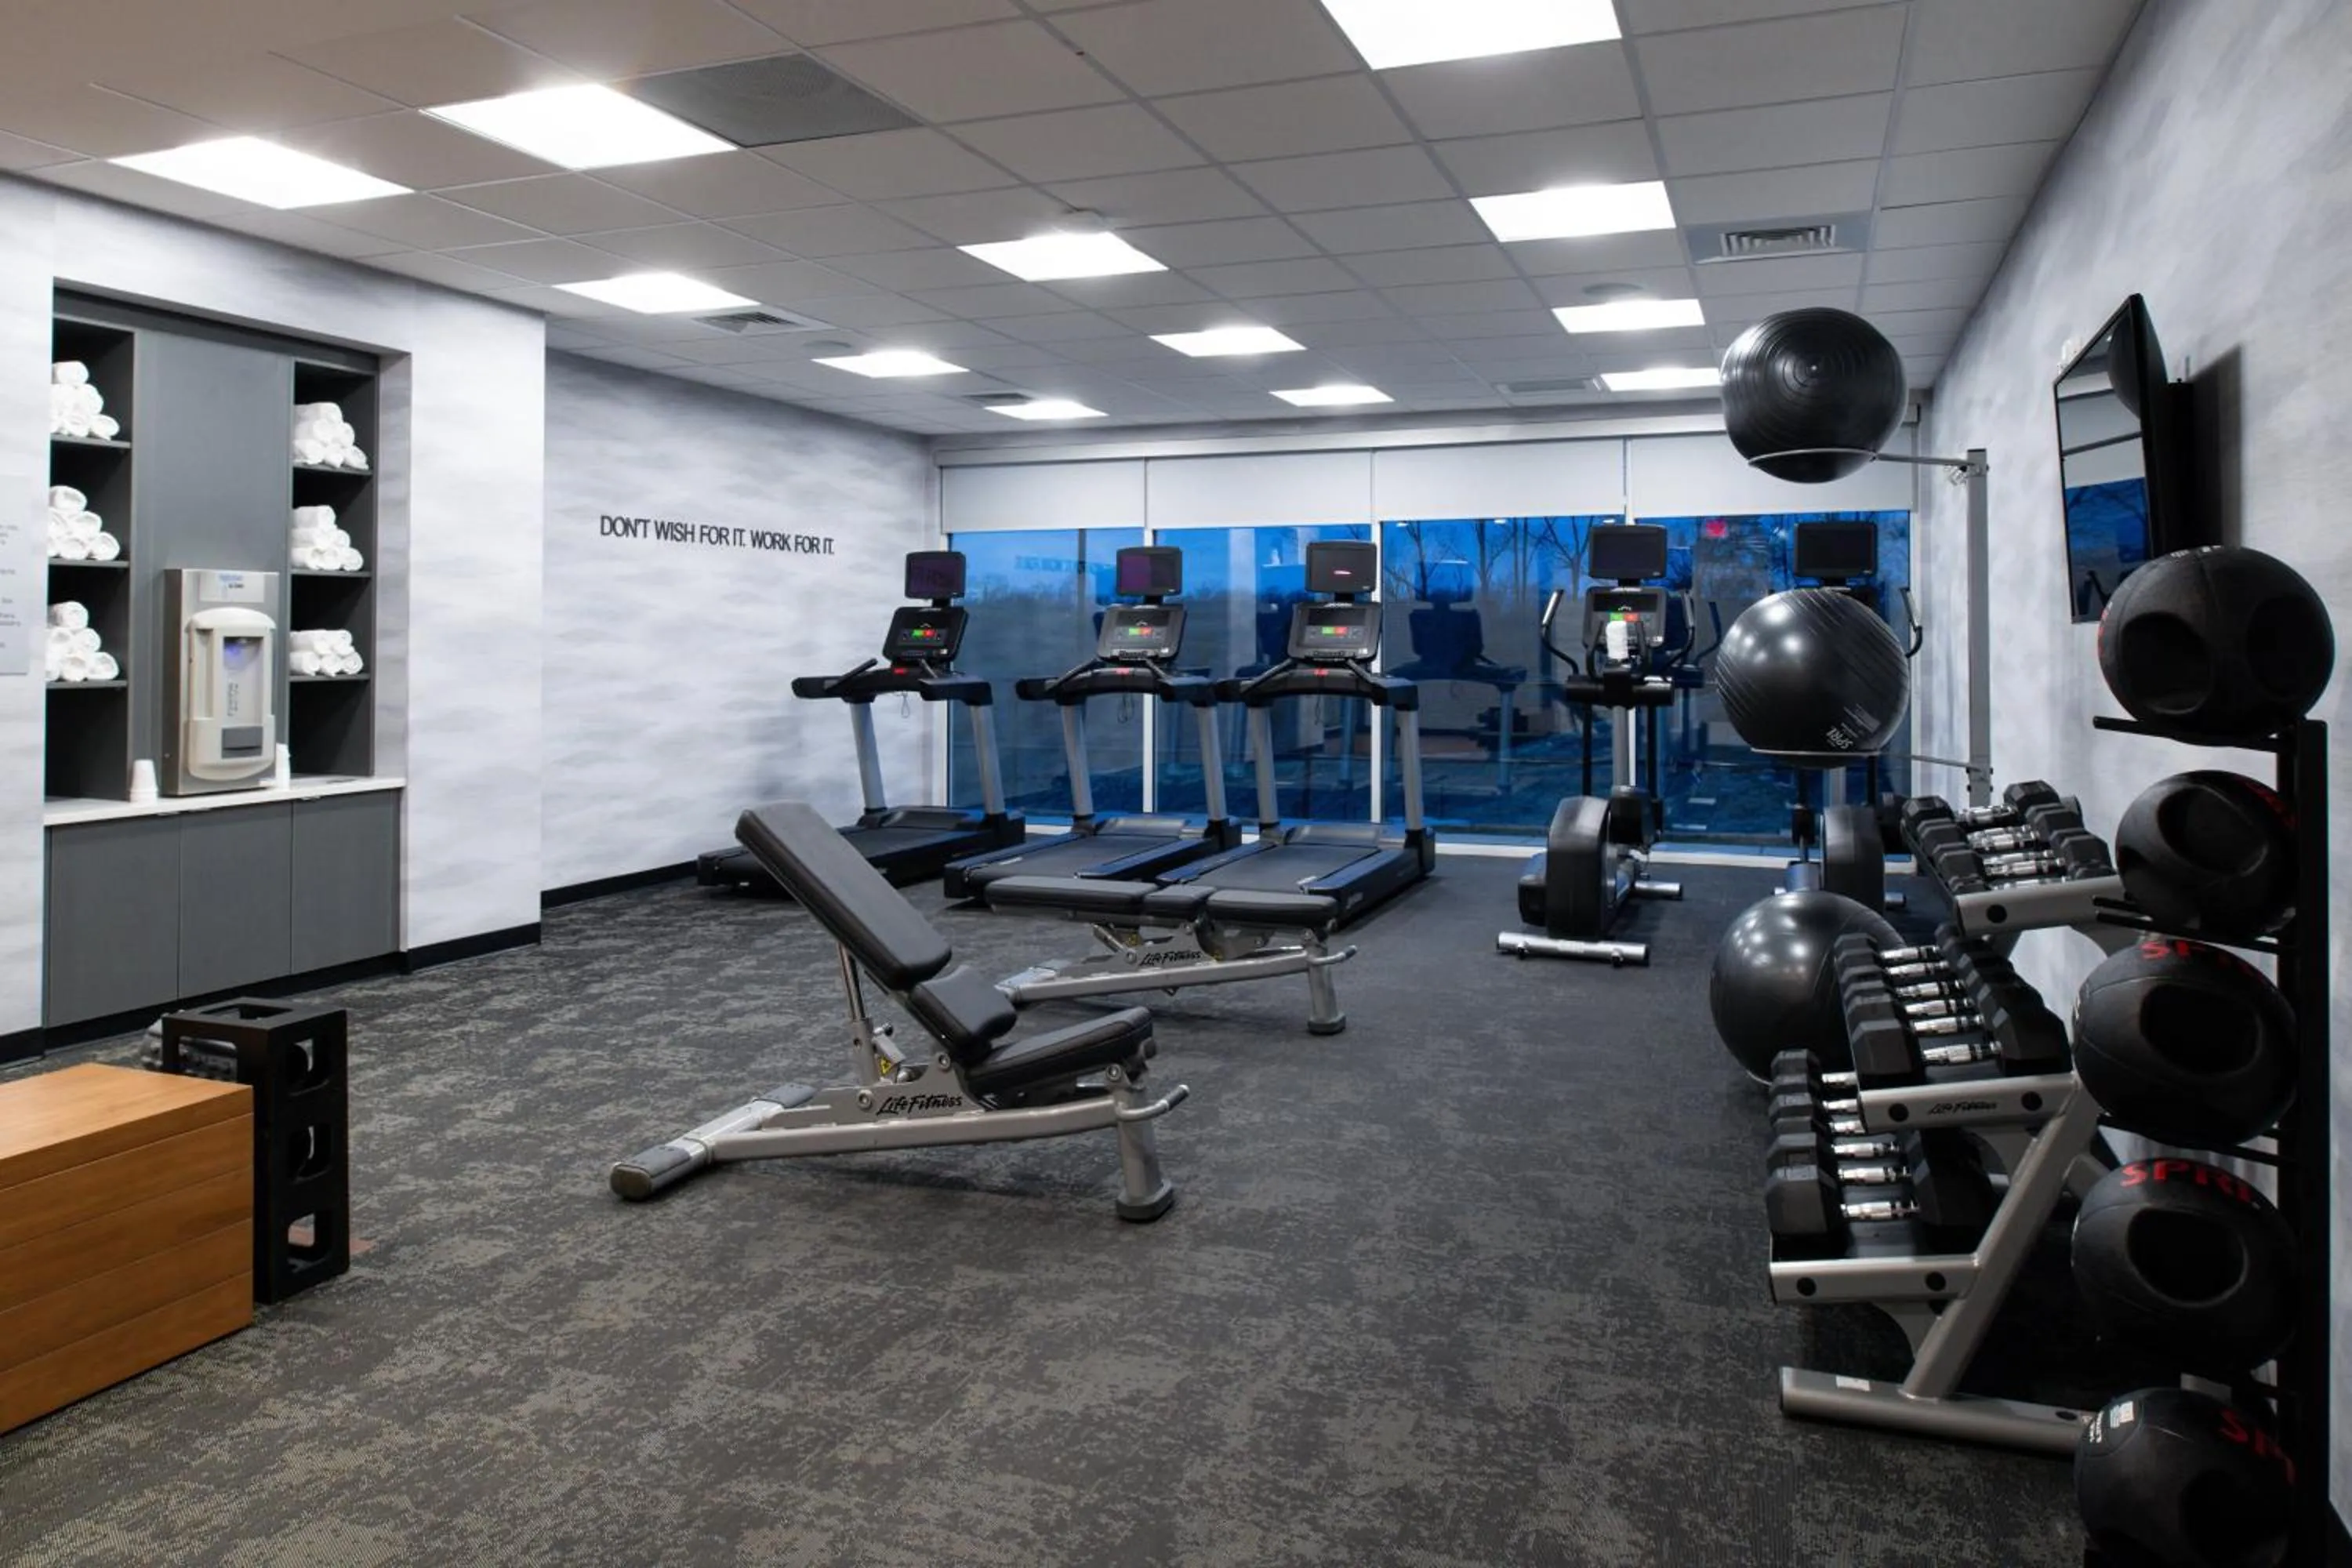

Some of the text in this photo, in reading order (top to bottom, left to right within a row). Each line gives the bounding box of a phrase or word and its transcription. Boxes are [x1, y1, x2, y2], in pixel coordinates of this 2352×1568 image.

[600, 515, 651, 539] DON'T
[654, 519, 695, 543] WISH
[699, 524, 730, 546] FOR
[750, 529, 792, 552] WORK
[794, 535, 821, 554] FOR
